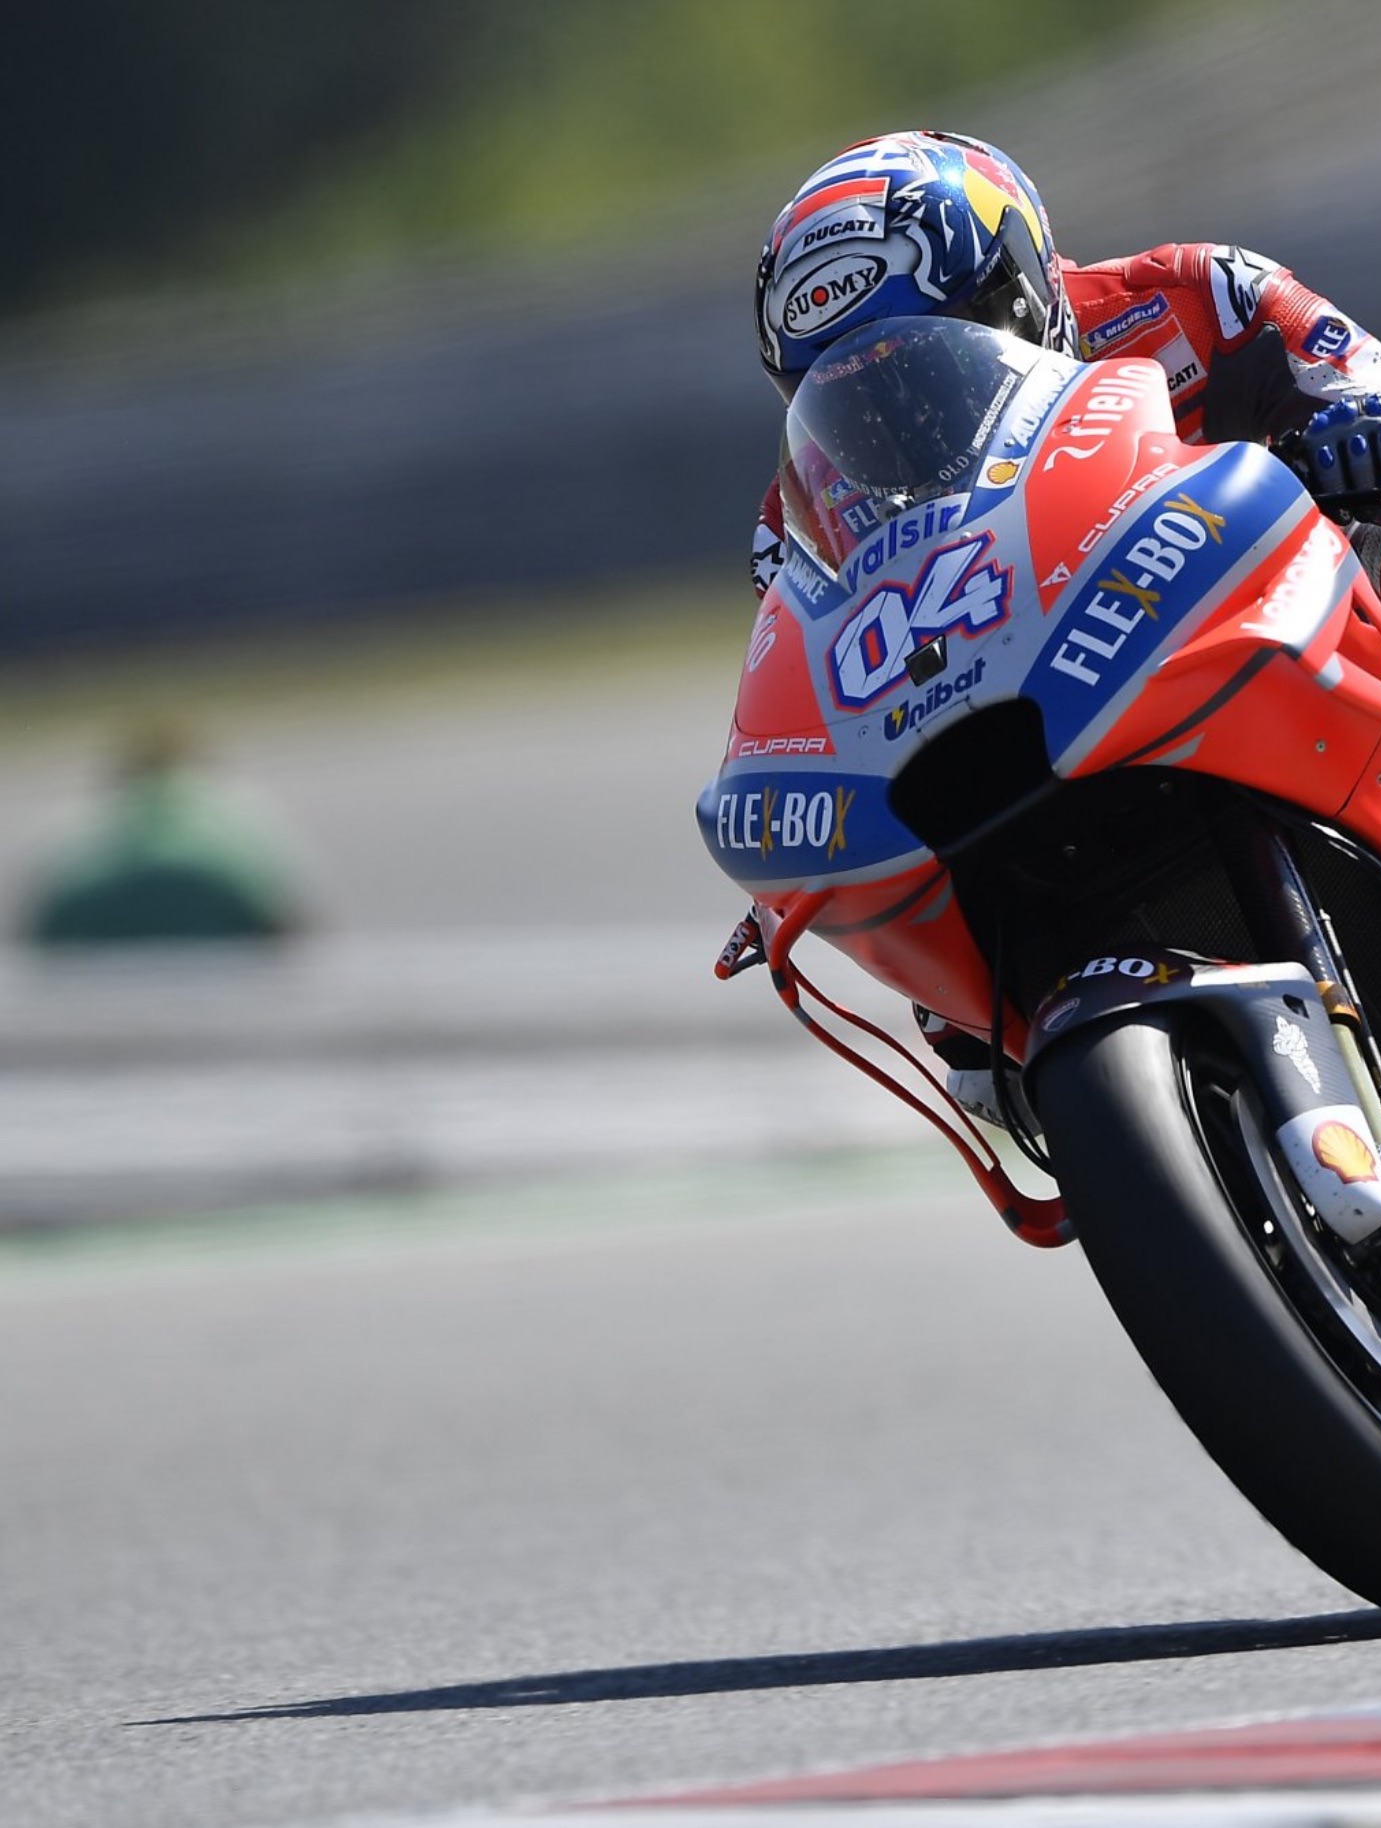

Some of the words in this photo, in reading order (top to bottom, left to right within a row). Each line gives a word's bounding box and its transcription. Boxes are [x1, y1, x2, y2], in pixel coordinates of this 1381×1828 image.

[803, 220, 876, 250] DUCATI
[786, 267, 876, 322] SUOMY
[1105, 302, 1161, 336] MICHELIN
[1168, 362, 1198, 392] CATI
[1078, 462, 1181, 553] CUPRA
[846, 503, 963, 594] valsir
[828, 531, 1013, 710] 04
[1050, 492, 1227, 686] FLEX-BOX
[884, 657, 987, 741] Unibat
[739, 737, 827, 757] CUPRA
[716, 785, 856, 861] FLEX-BOX
